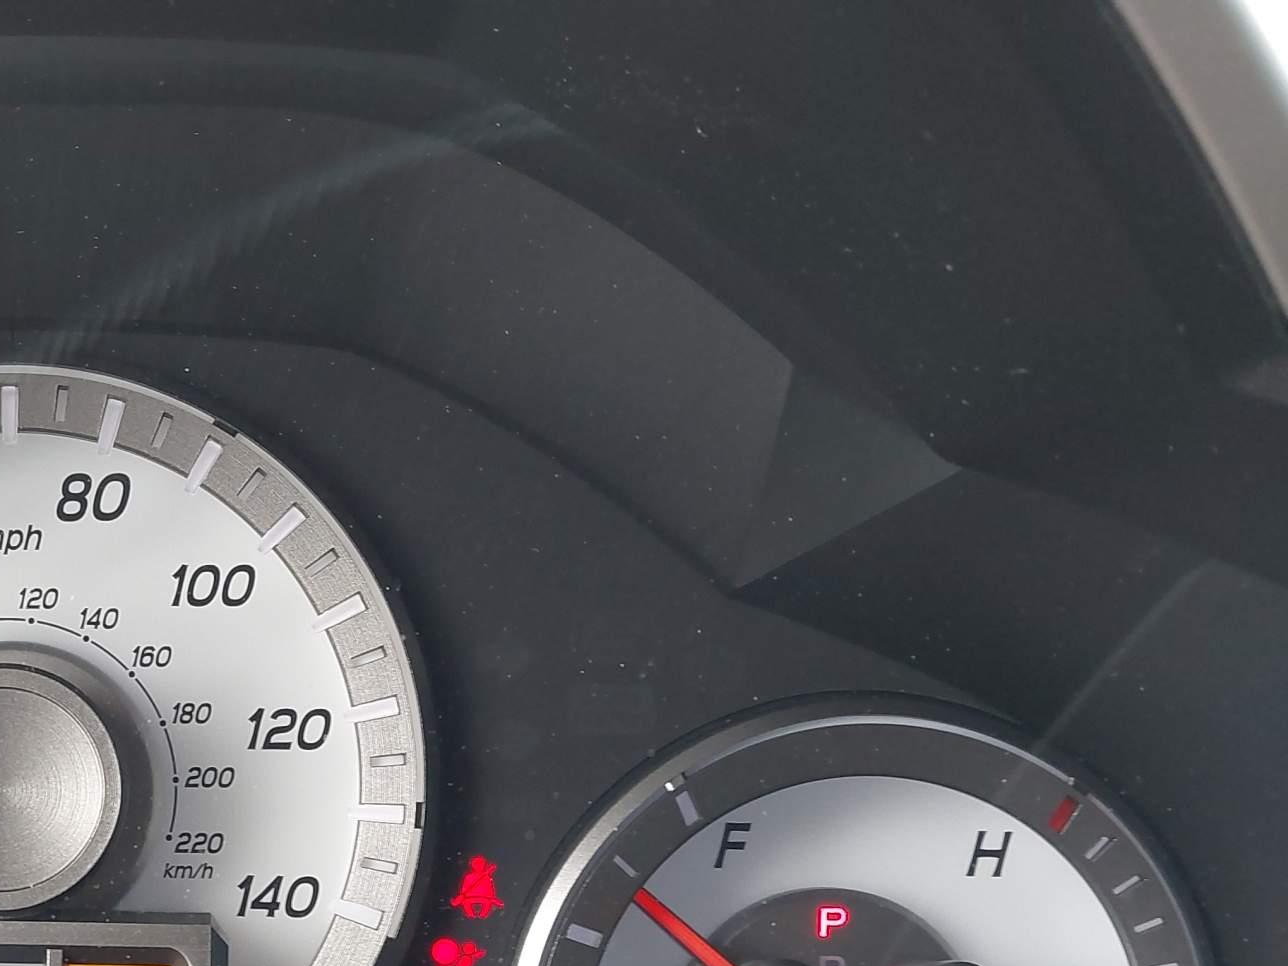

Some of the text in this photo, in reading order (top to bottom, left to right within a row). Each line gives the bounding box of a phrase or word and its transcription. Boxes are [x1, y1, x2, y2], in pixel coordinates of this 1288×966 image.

[55, 471, 132, 523] 80
[18, 587, 60, 610] 120
[170, 563, 257, 608] 100
[79, 607, 120, 630] 140
[131, 646, 172, 668] 160
[172, 702, 213, 725] 180
[247, 707, 332, 751] 120
[184, 766, 236, 789] 200
[173, 831, 225, 855] 220
[713, 821, 752, 869] F
[965, 829, 1015, 878] H
[162, 862, 214, 881] km/h
[236, 874, 320, 919] 140
[816, 905, 850, 939] P
